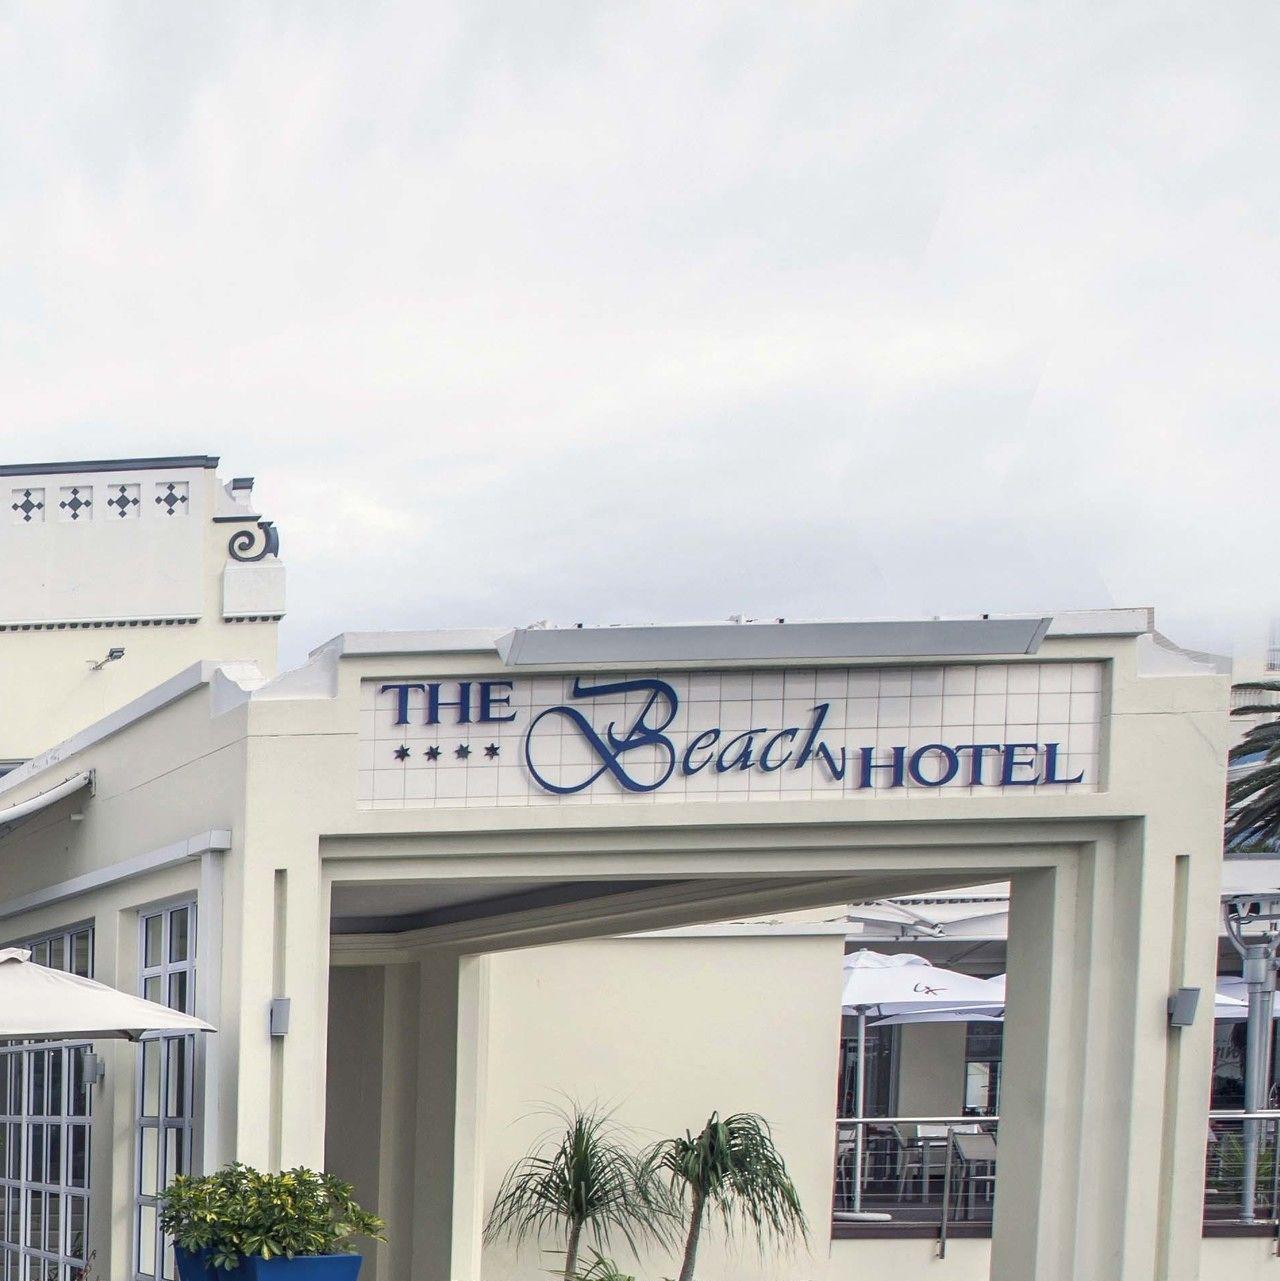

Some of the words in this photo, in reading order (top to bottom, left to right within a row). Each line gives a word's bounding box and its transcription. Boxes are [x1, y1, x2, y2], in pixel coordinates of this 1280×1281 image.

[380, 681, 517, 725] THE
[525, 677, 847, 794] Beach
[858, 742, 1085, 789] HOTEL
